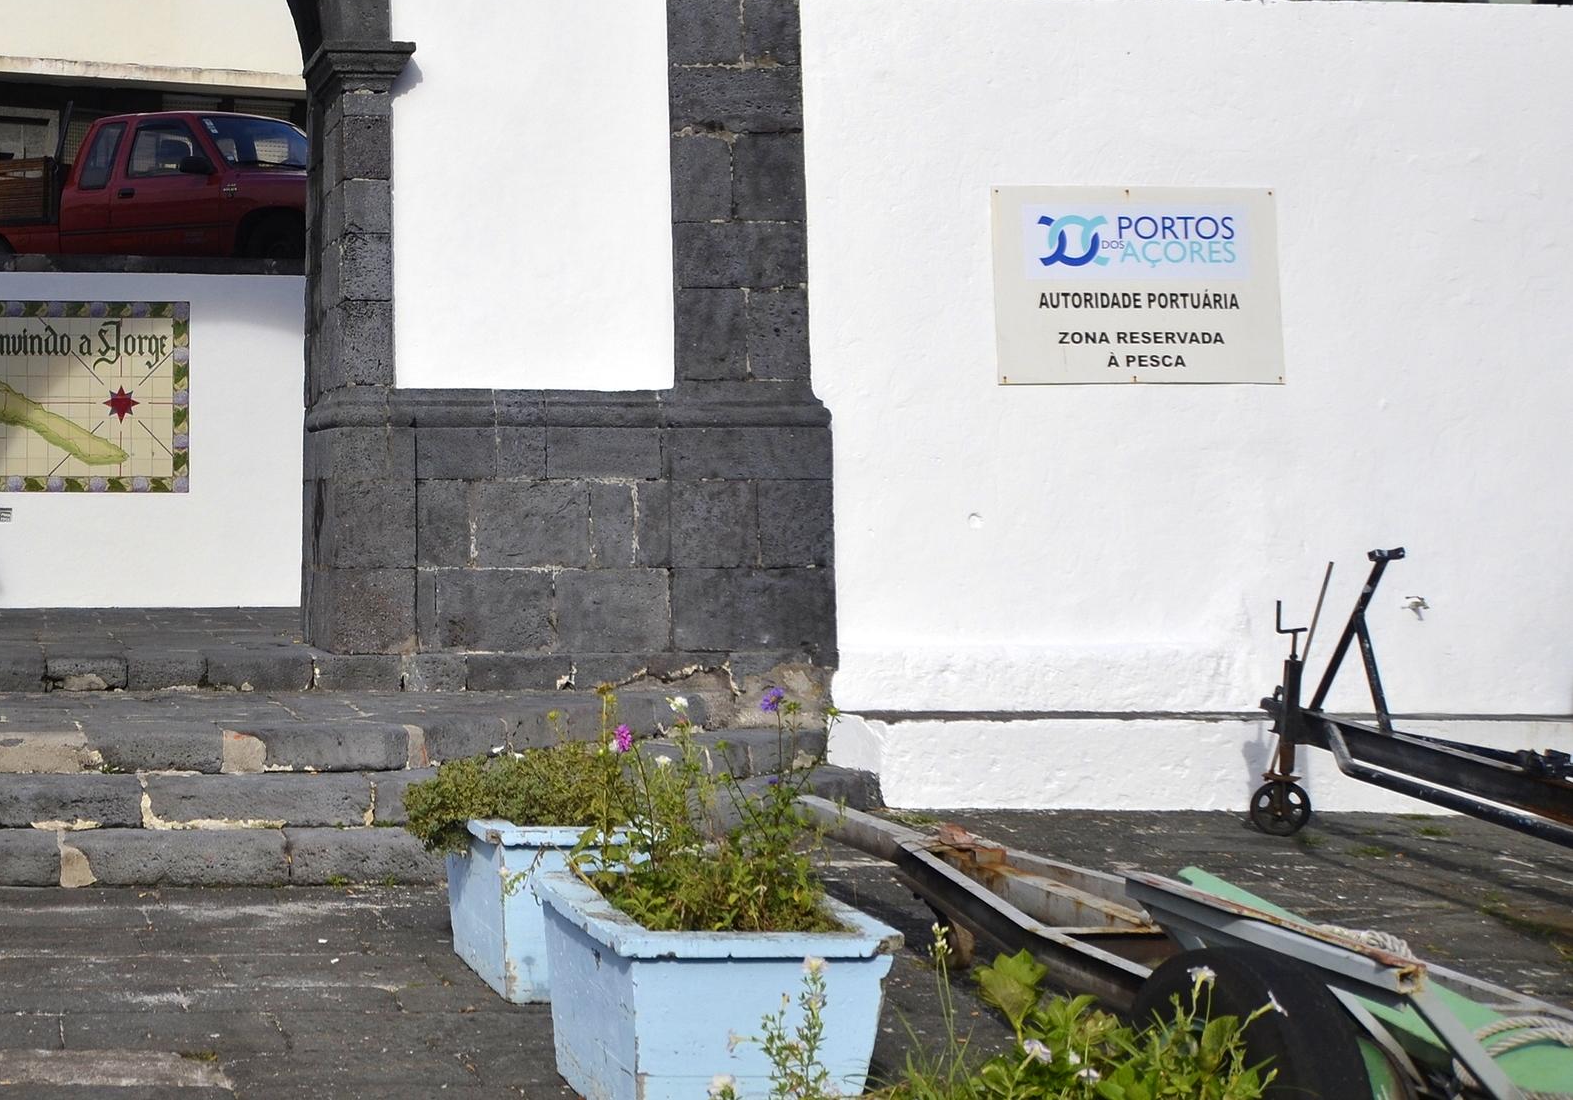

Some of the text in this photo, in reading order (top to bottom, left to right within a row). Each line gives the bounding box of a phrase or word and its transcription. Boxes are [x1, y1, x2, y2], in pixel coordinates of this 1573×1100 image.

[1118, 216, 1235, 240] PORTOS
[1101, 239, 1237, 268] DOS AÇORES
[1038, 289, 1240, 310] AUTORIDADE PORTUÁRIA
[78, 333, 92, 356] a
[1058, 331, 1225, 345] ZONA RESERVADA
[1107, 352, 1186, 368] À PESCA
